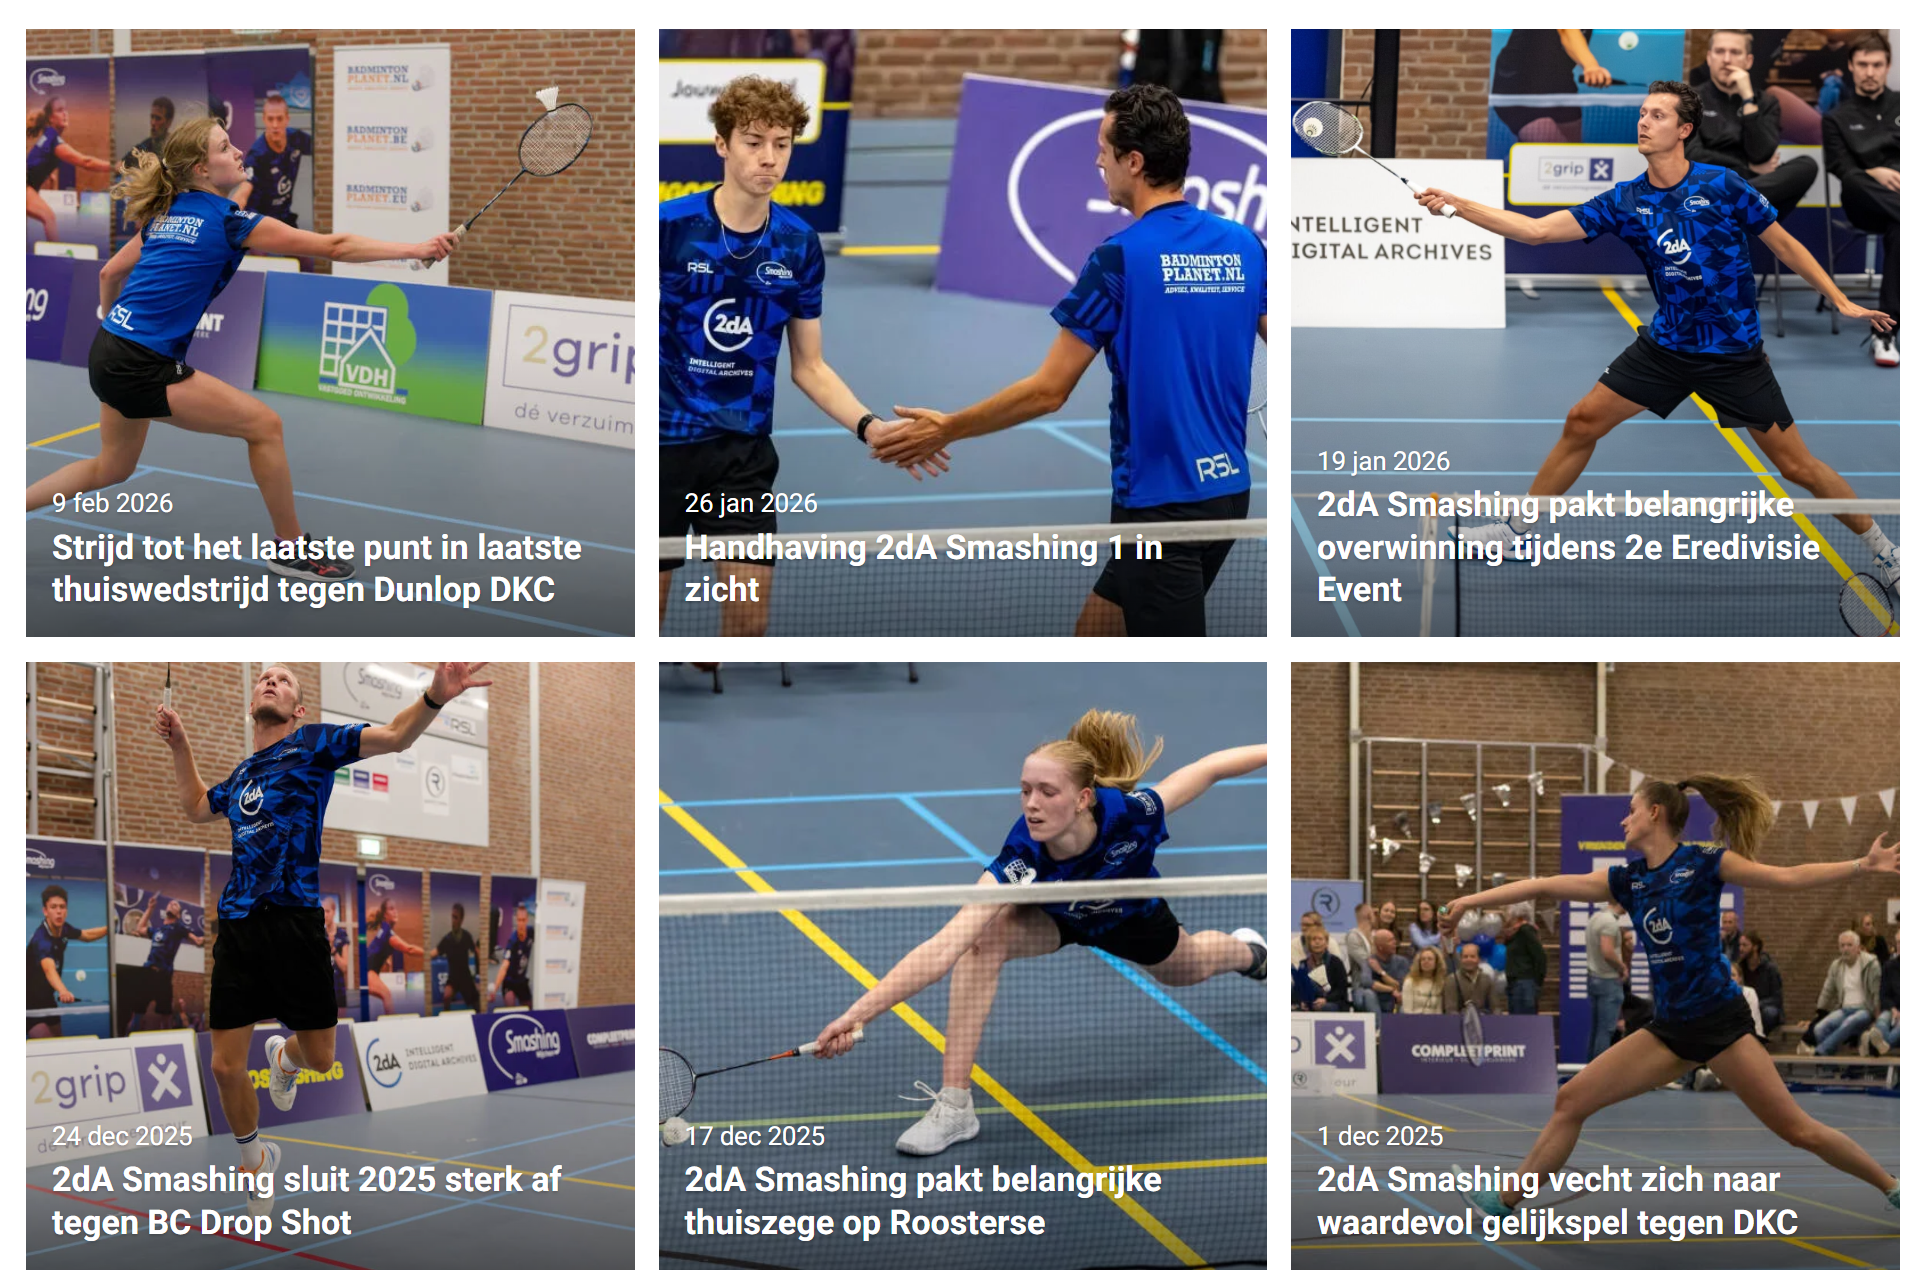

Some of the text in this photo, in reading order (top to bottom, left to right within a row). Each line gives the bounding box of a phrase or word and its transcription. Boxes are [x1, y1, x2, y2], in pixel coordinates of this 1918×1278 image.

[1544, 161, 1584, 178] 2grip
[1374, 243, 1493, 261] ARCHIVES
[1663, 238, 1692, 255] 2dA
[687, 262, 714, 274] RSL
[1160, 253, 1242, 267] BADMINTON
[1162, 267, 1245, 282] PLANET.NL
[713, 314, 754, 336] 2dA
[687, 366, 754, 377] DIGITAL ARCHIVES
[689, 357, 736, 369] INTELLIGENT
[345, 363, 389, 388] VDH
[514, 402, 540, 420] dé
[1195, 452, 1240, 483] RSL
[451, 717, 476, 737] RSL
[243, 785, 264, 806] 2dA
[1649, 917, 1673, 934] 2dA
[404, 1043, 454, 1057] INTELLIGENT
[505, 1027, 561, 1056] Smashing
[1411, 1044, 1526, 1058] COMPLEETPRINT
[373, 1054, 402, 1073] 2dA
[408, 1054, 478, 1071] DIGITAL ARCHIVES
[31, 1064, 126, 1110] 2grip
